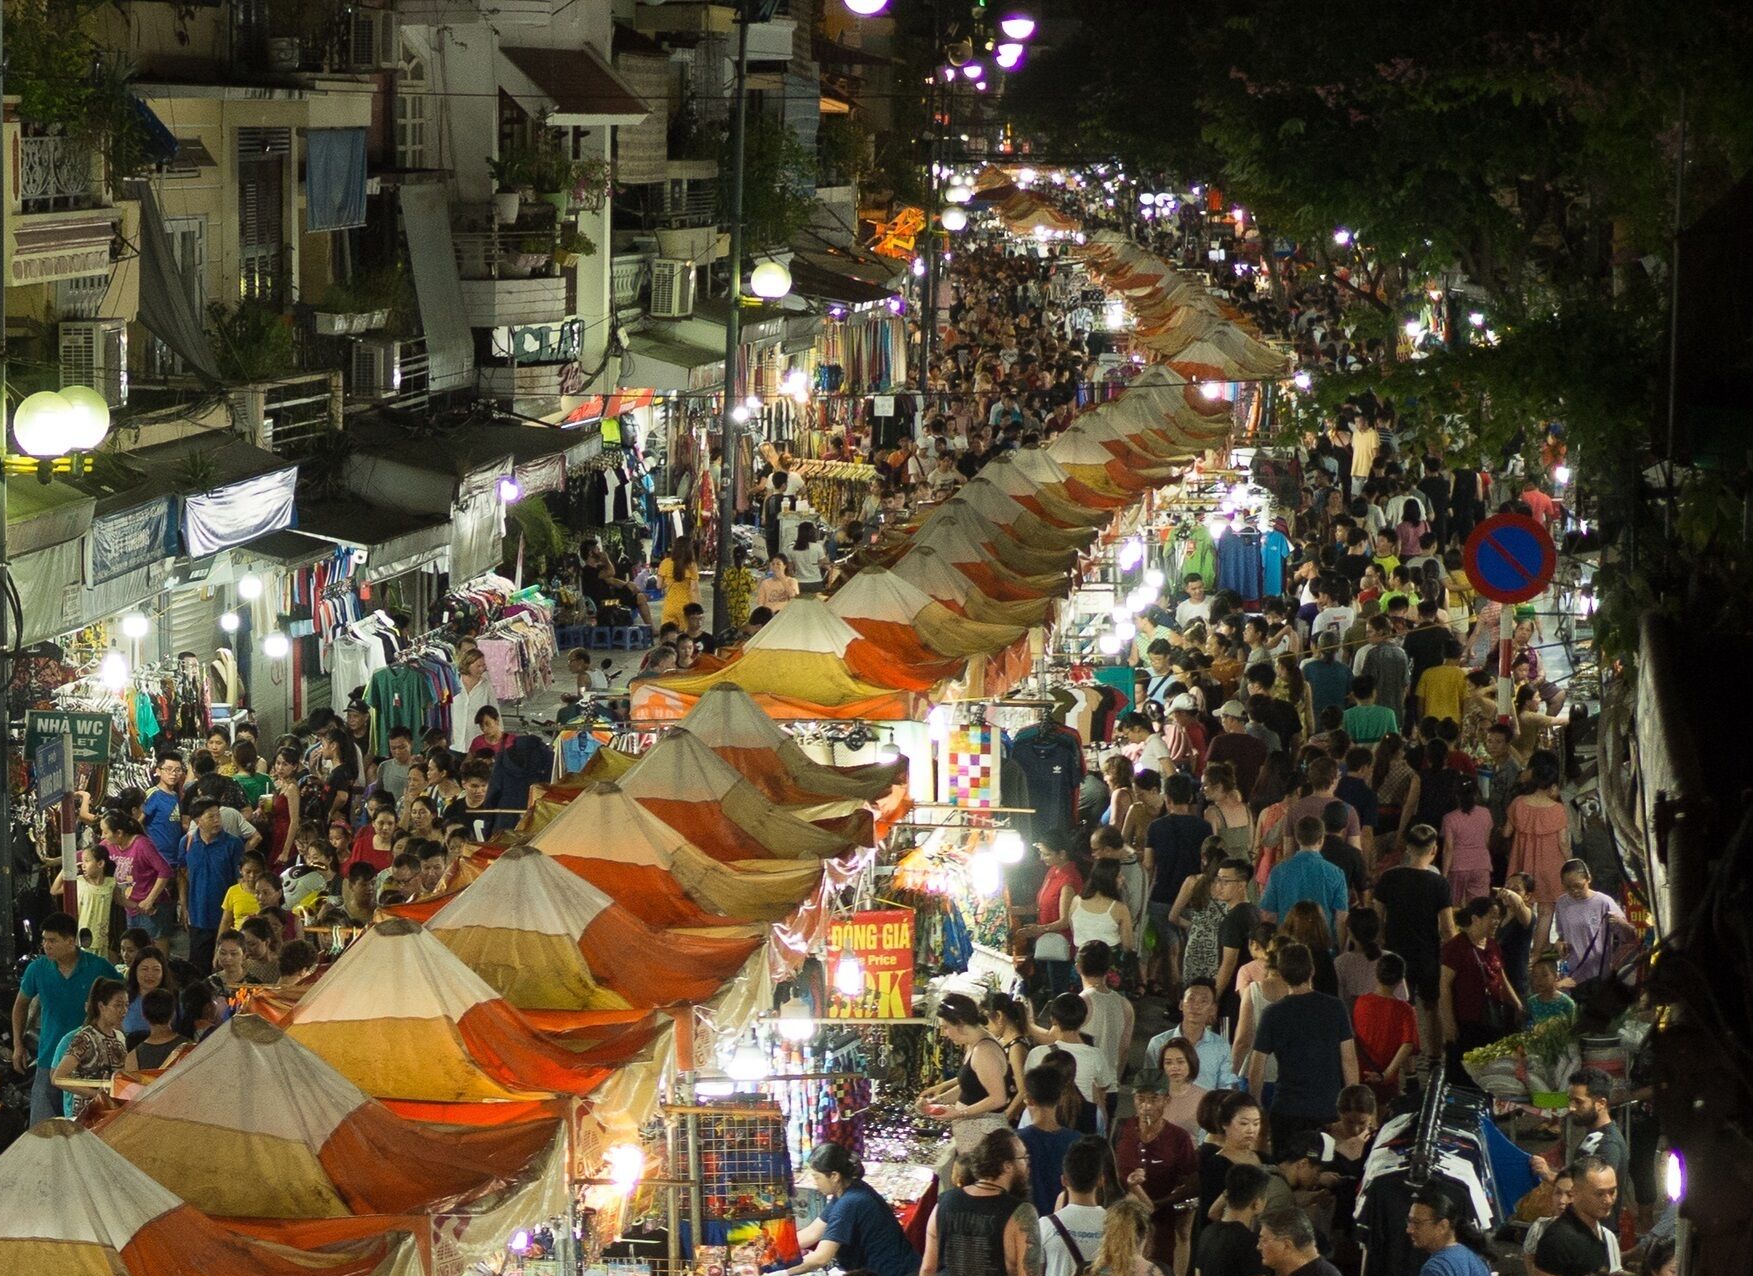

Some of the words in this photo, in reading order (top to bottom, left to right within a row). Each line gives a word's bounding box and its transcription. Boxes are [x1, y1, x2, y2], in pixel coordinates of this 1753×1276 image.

[36, 715, 71, 734] NHÀ
[76, 719, 104, 736] WC
[881, 917, 911, 950] GIÁ
[868, 954, 897, 967] Price
